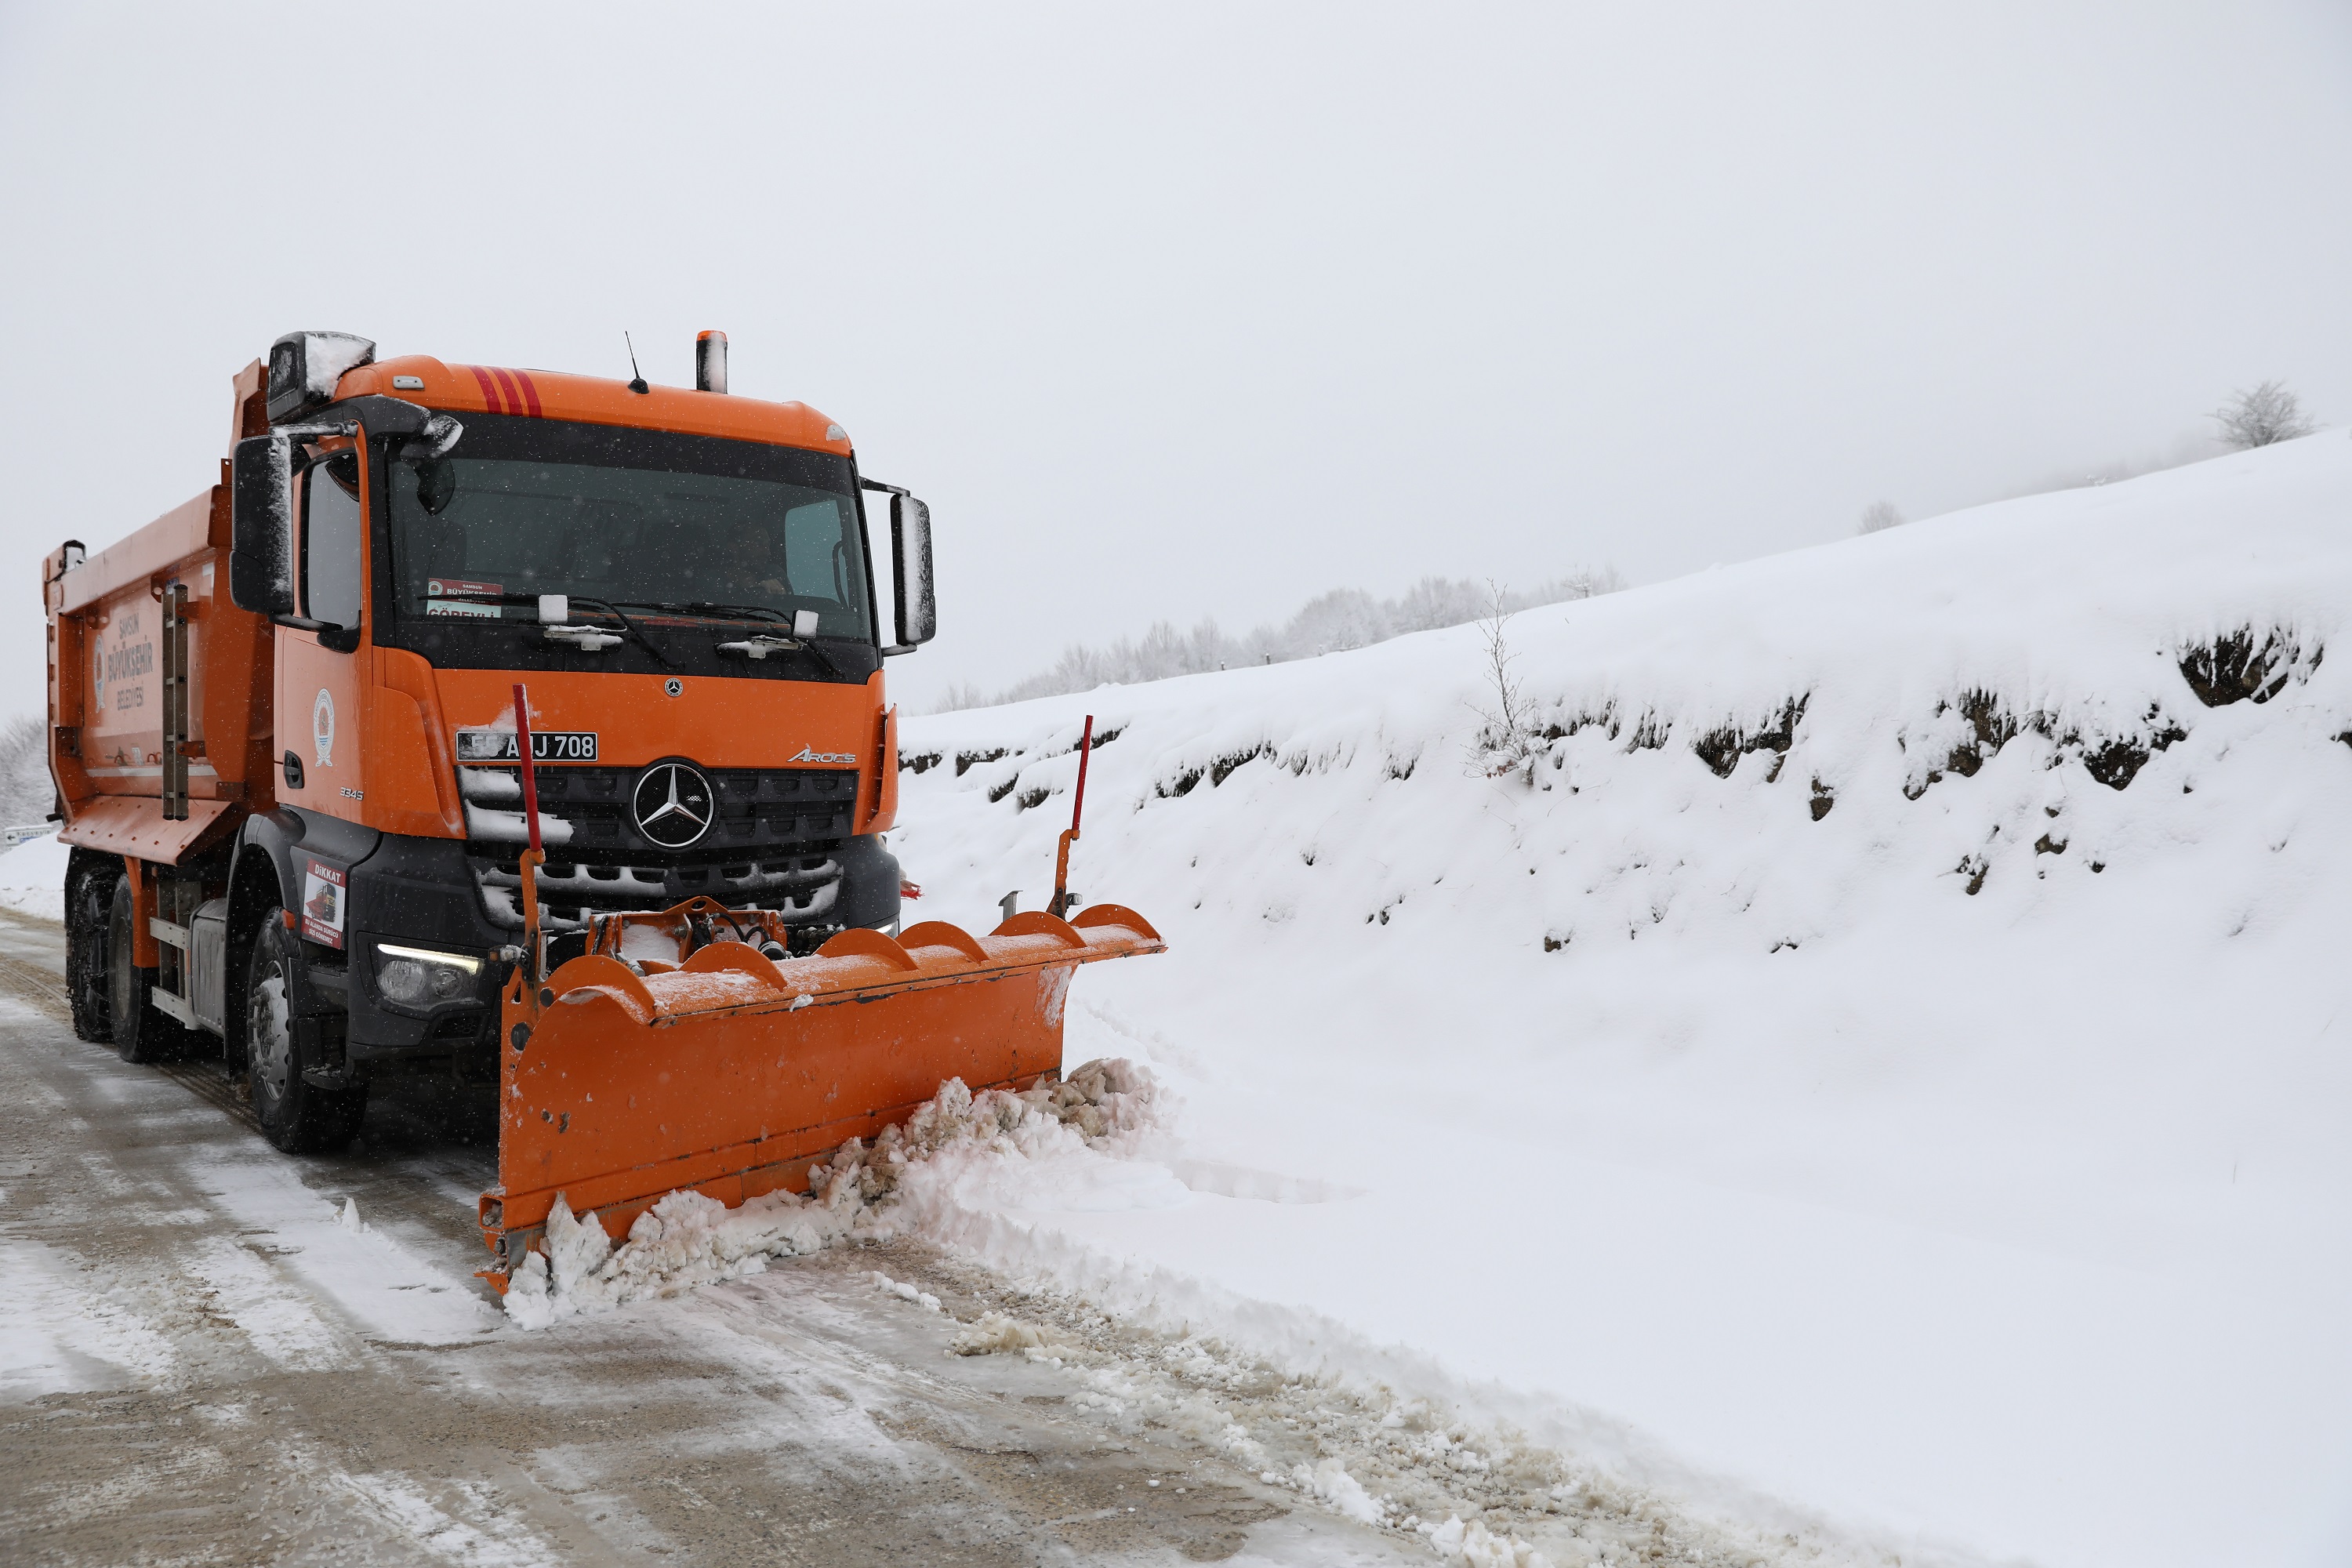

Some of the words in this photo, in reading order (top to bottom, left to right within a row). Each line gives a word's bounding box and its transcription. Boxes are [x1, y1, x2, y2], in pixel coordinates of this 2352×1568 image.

[119, 612, 139, 640] SAMSUN
[108, 634, 153, 682] BÜYÜKŞEHİR
[118, 680, 143, 710] BELEDİYESİ
[506, 735, 547, 757] AJ
[554, 735, 593, 757] 708
[339, 786, 364, 801] 3345
[310, 920, 323, 932] ALANDA
